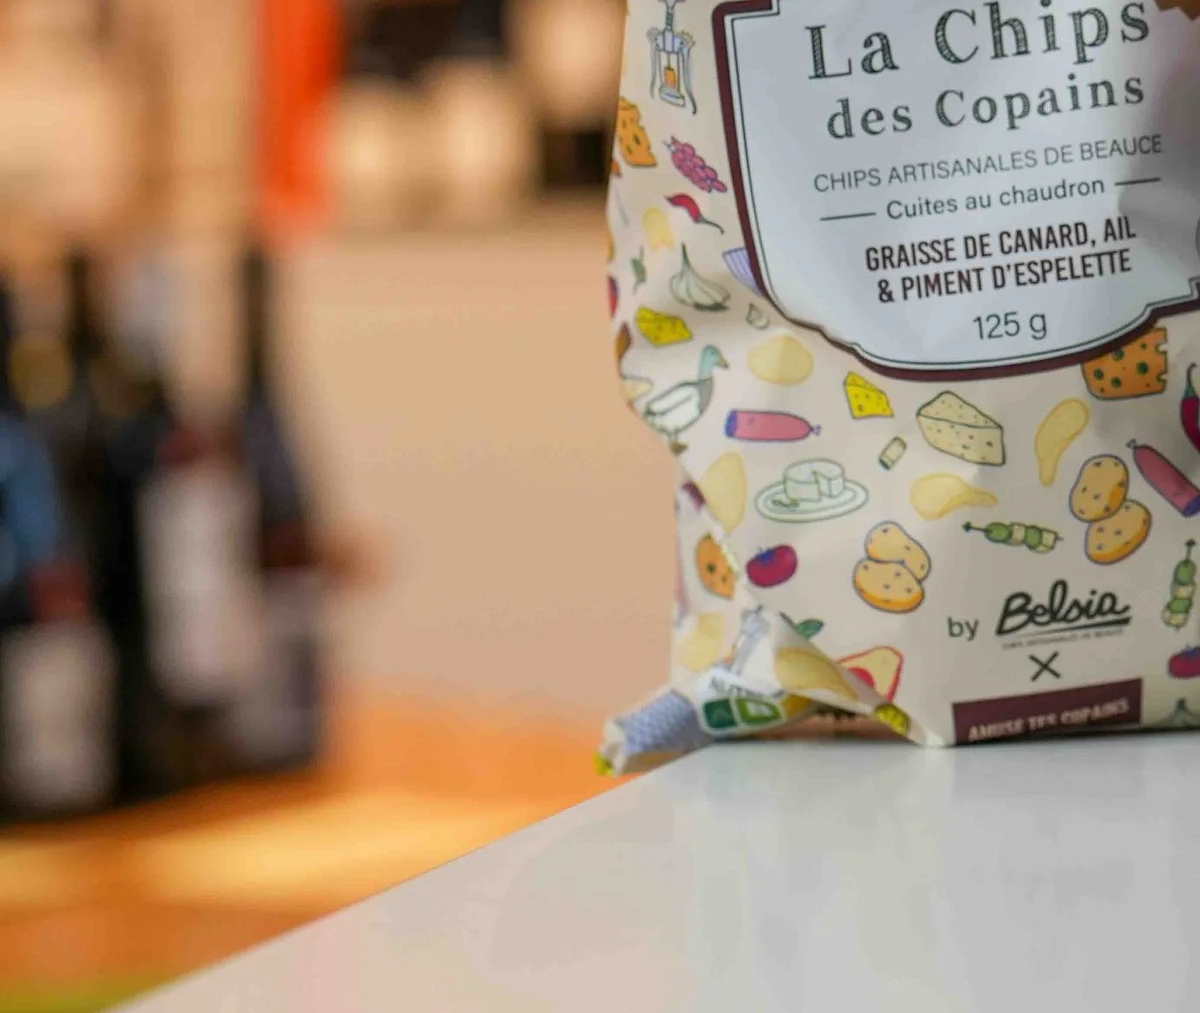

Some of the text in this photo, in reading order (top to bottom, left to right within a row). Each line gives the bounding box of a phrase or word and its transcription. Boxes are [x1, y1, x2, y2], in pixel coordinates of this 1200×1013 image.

[804, 24, 899, 79] La
[827, 73, 1145, 139] des Copains
[814, 134, 1163, 193] CHIPS ARTISANALES DE BEAUCE
[886, 178, 1106, 221] Cuites au chaudron
[865, 215, 1136, 273] GRAISSE DE CANARD, AIL
[877, 248, 1132, 302] & PIMENT D'ESPELETTE
[973, 312, 1048, 340] 125 g
[947, 617, 980, 641] by
[995, 579, 1131, 636] Belsia
